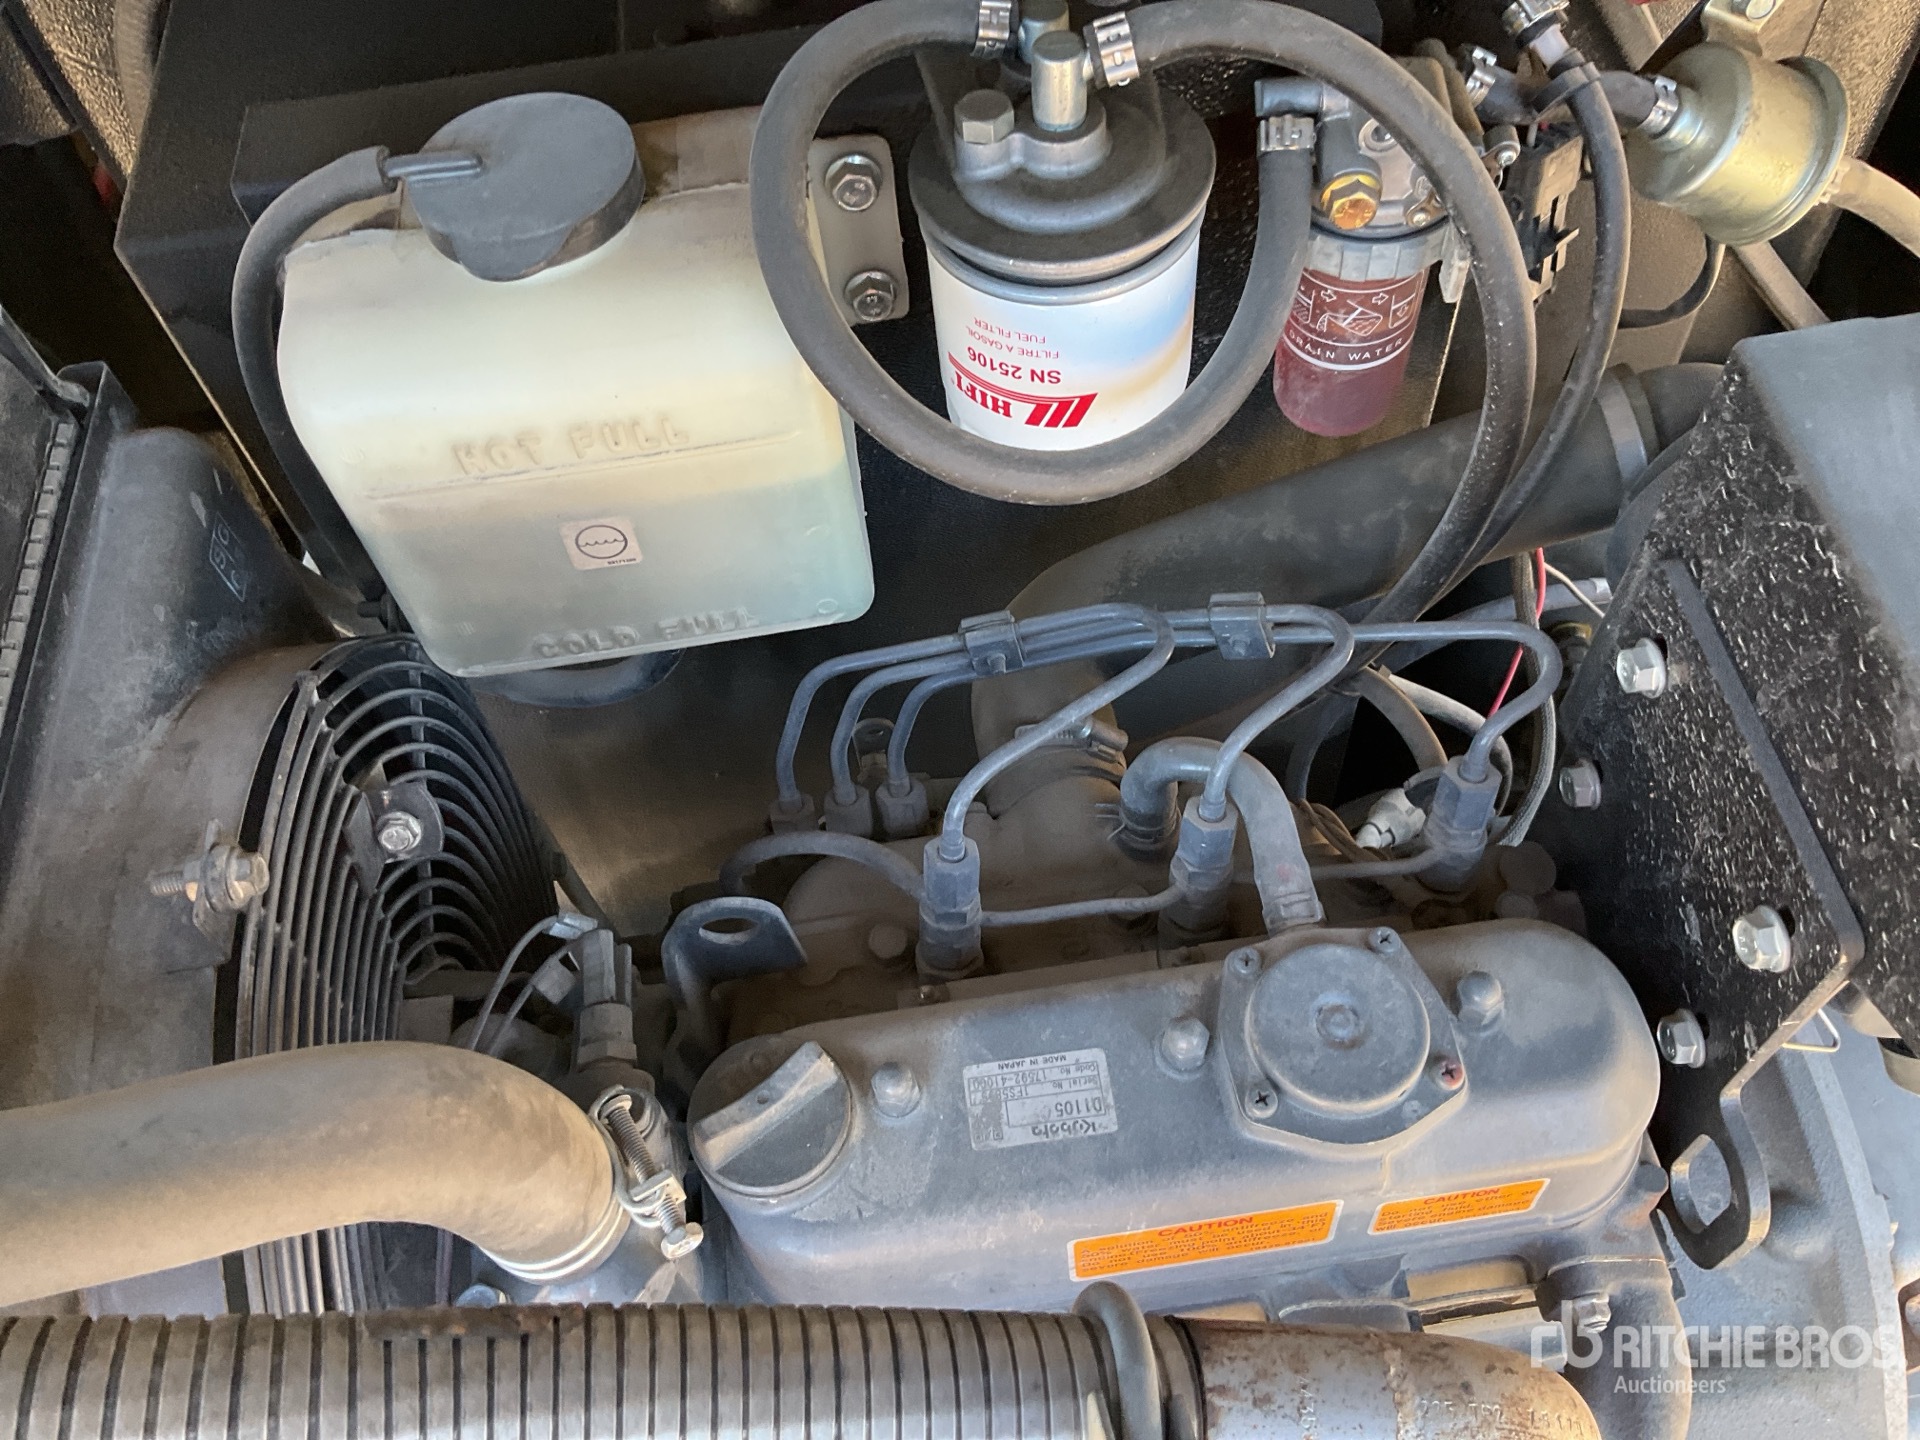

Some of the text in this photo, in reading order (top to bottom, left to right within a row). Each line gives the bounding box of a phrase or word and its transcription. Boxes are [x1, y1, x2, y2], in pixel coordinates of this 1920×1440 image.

[966, 325, 1002, 350] GASOIL
[974, 317, 1046, 343] FUEL FILTER
[1018, 347, 1059, 358] FILTRE
[1289, 330, 1402, 360] DRAIN WATER
[967, 346, 1061, 384] SN 25106
[955, 371, 1012, 417] HIFI
[451, 416, 689, 475] HOT FULL
[534, 607, 760, 658] COLD FULL
[998, 1061, 1025, 1070] JAPAN
[1043, 1055, 1066, 1064] MADE
[1075, 1064, 1096, 1074] Code
[1069, 1076, 1097, 1089] Serial
[1054, 1097, 1102, 1117] D1105
[1032, 1120, 1096, 1138] Kubota
[1423, 1188, 1500, 1204] CAUTION
[1158, 1216, 1253, 1236] CAUTION
